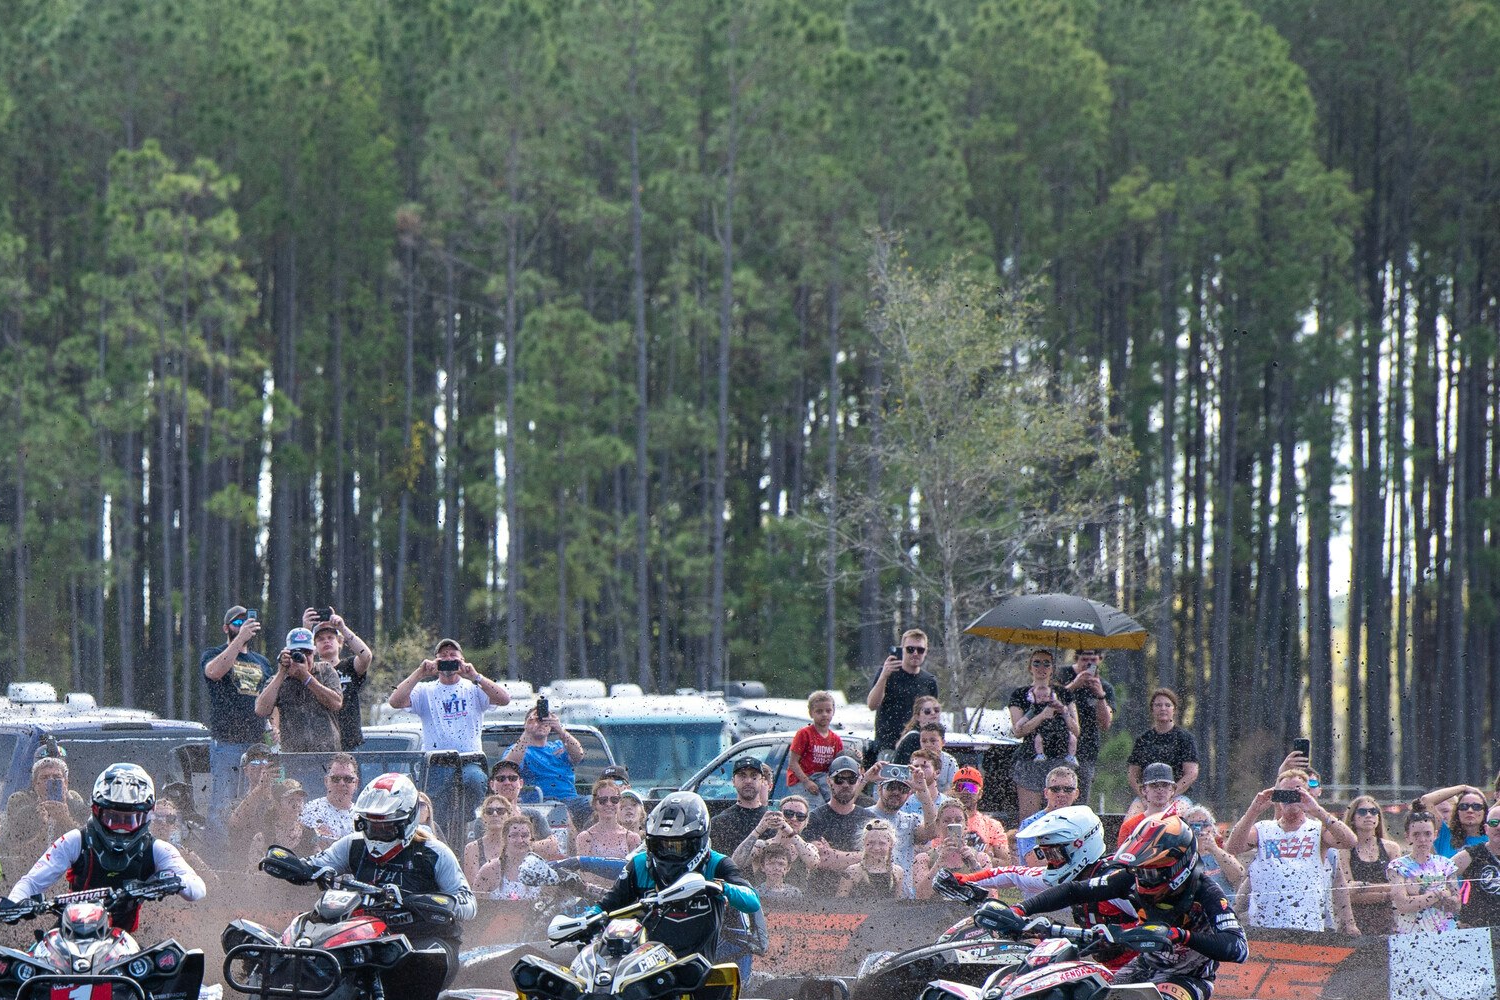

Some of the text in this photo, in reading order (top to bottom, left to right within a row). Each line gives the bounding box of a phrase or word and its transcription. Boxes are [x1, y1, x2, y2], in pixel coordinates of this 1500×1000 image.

[442, 699, 467, 714] WTF
[57, 890, 108, 905] RENTHAL
[1060, 966, 1091, 981] KENDA
